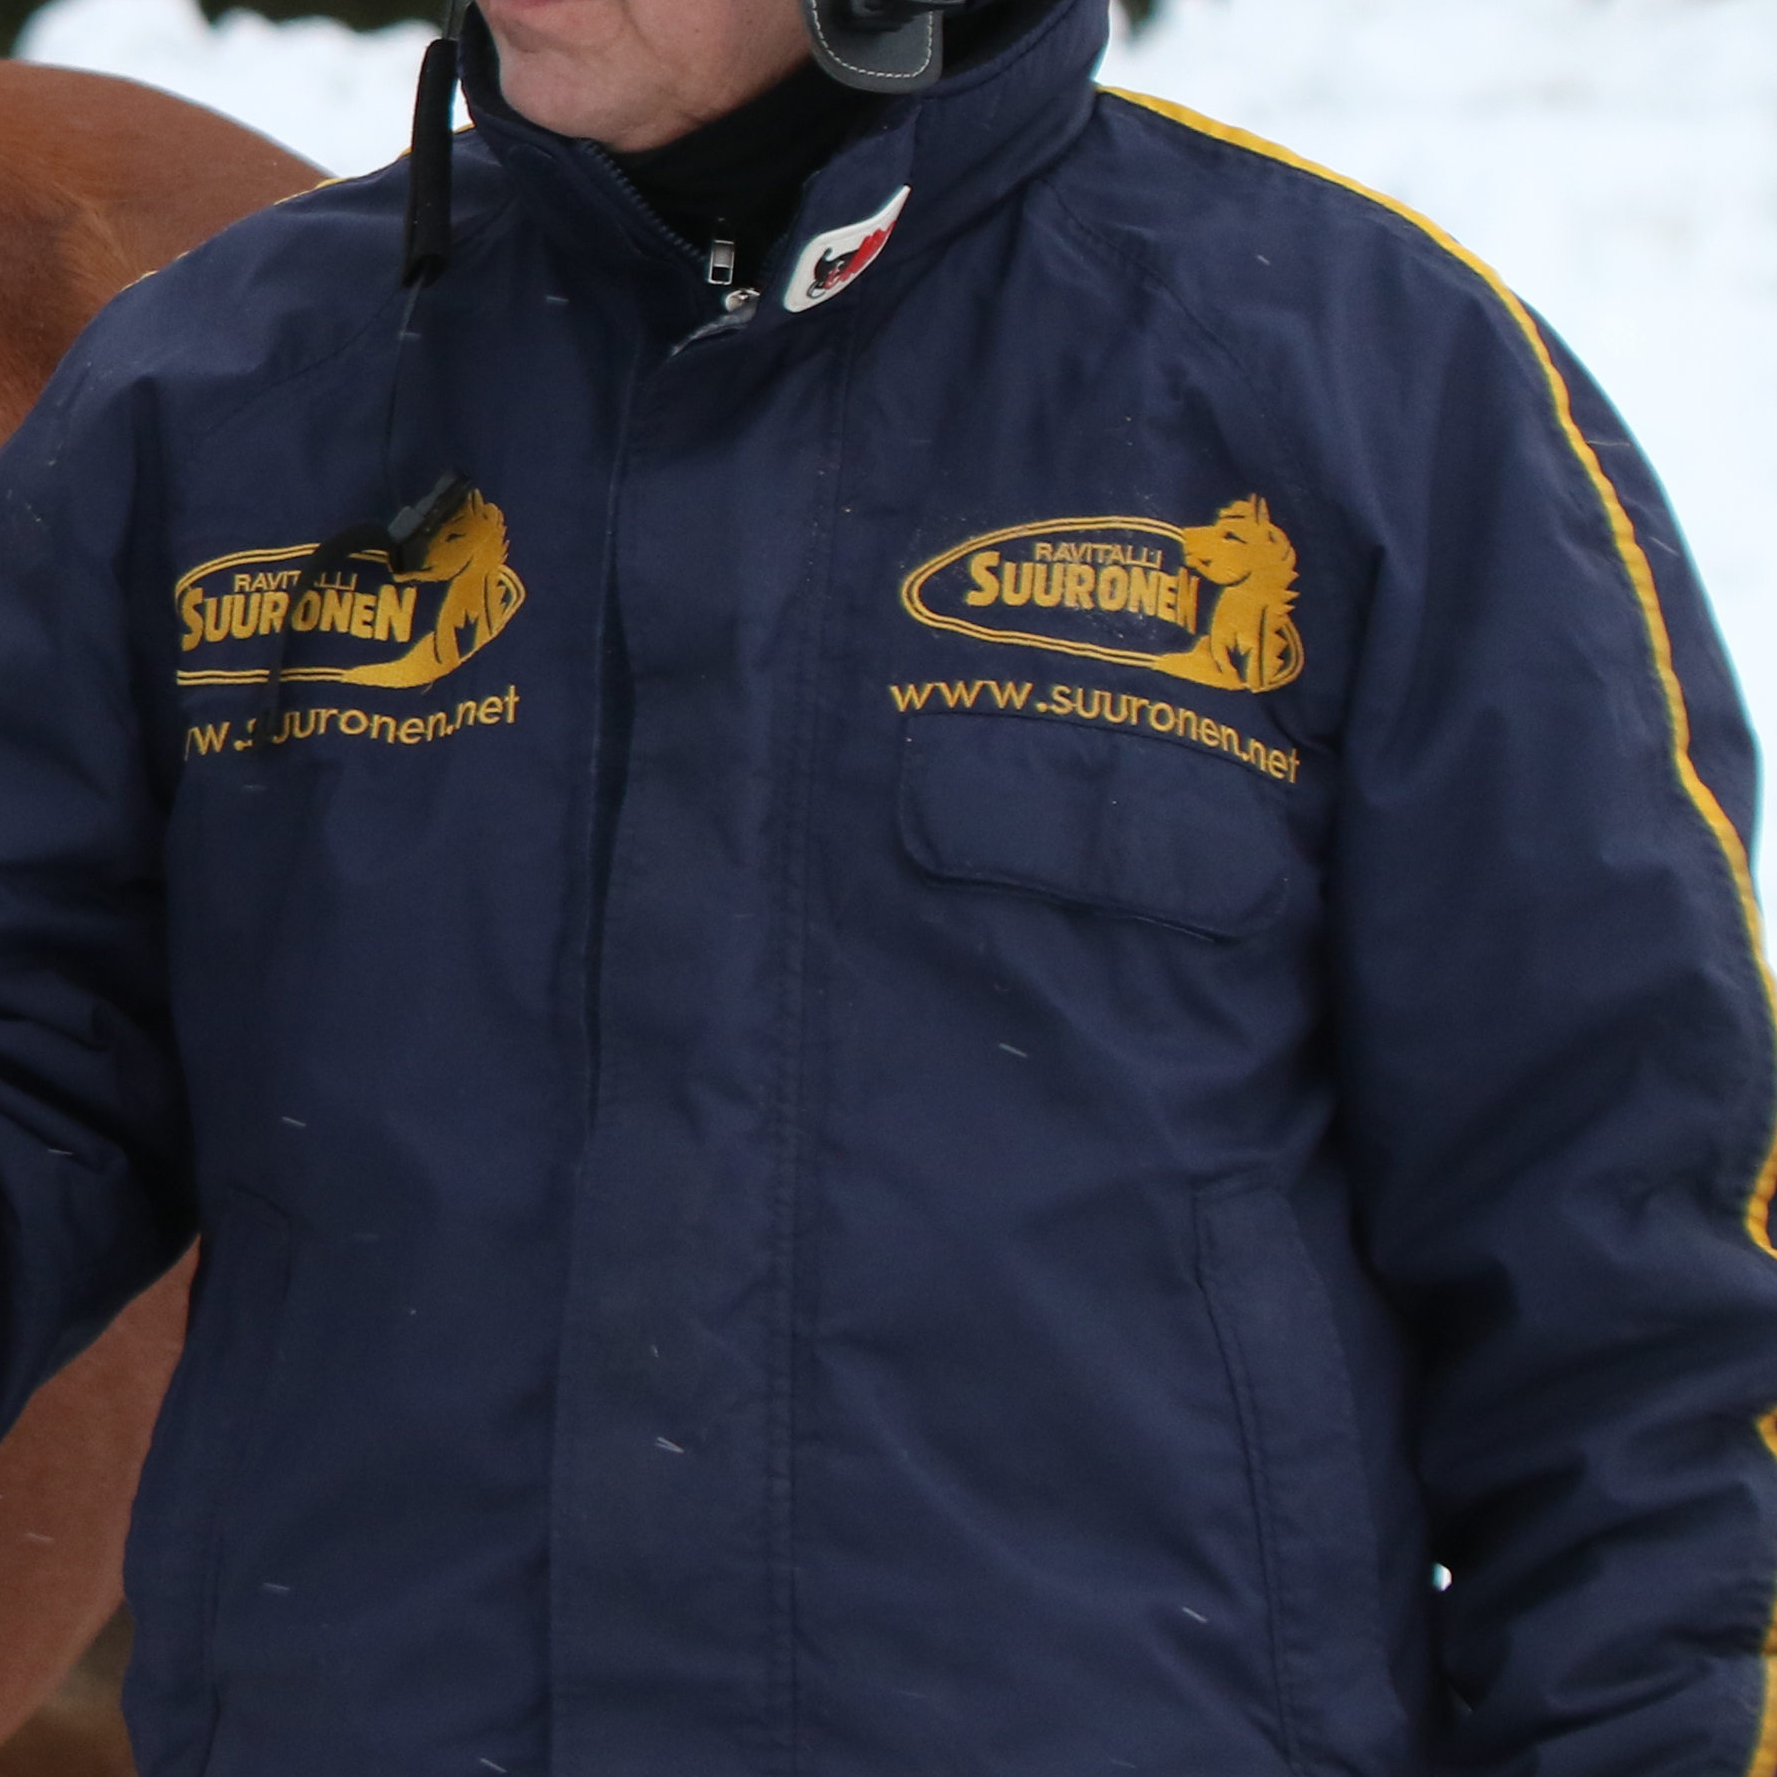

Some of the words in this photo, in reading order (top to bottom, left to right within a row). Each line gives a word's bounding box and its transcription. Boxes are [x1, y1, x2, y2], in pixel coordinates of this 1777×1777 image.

[234, 569, 359, 593] RAVITLLI
[1034, 542, 1164, 569] RAVITALLI
[181, 584, 418, 652] SUURONEN
[964, 550, 1201, 635] SUURONEN
[889, 679, 1302, 784] www.suuronen.net
